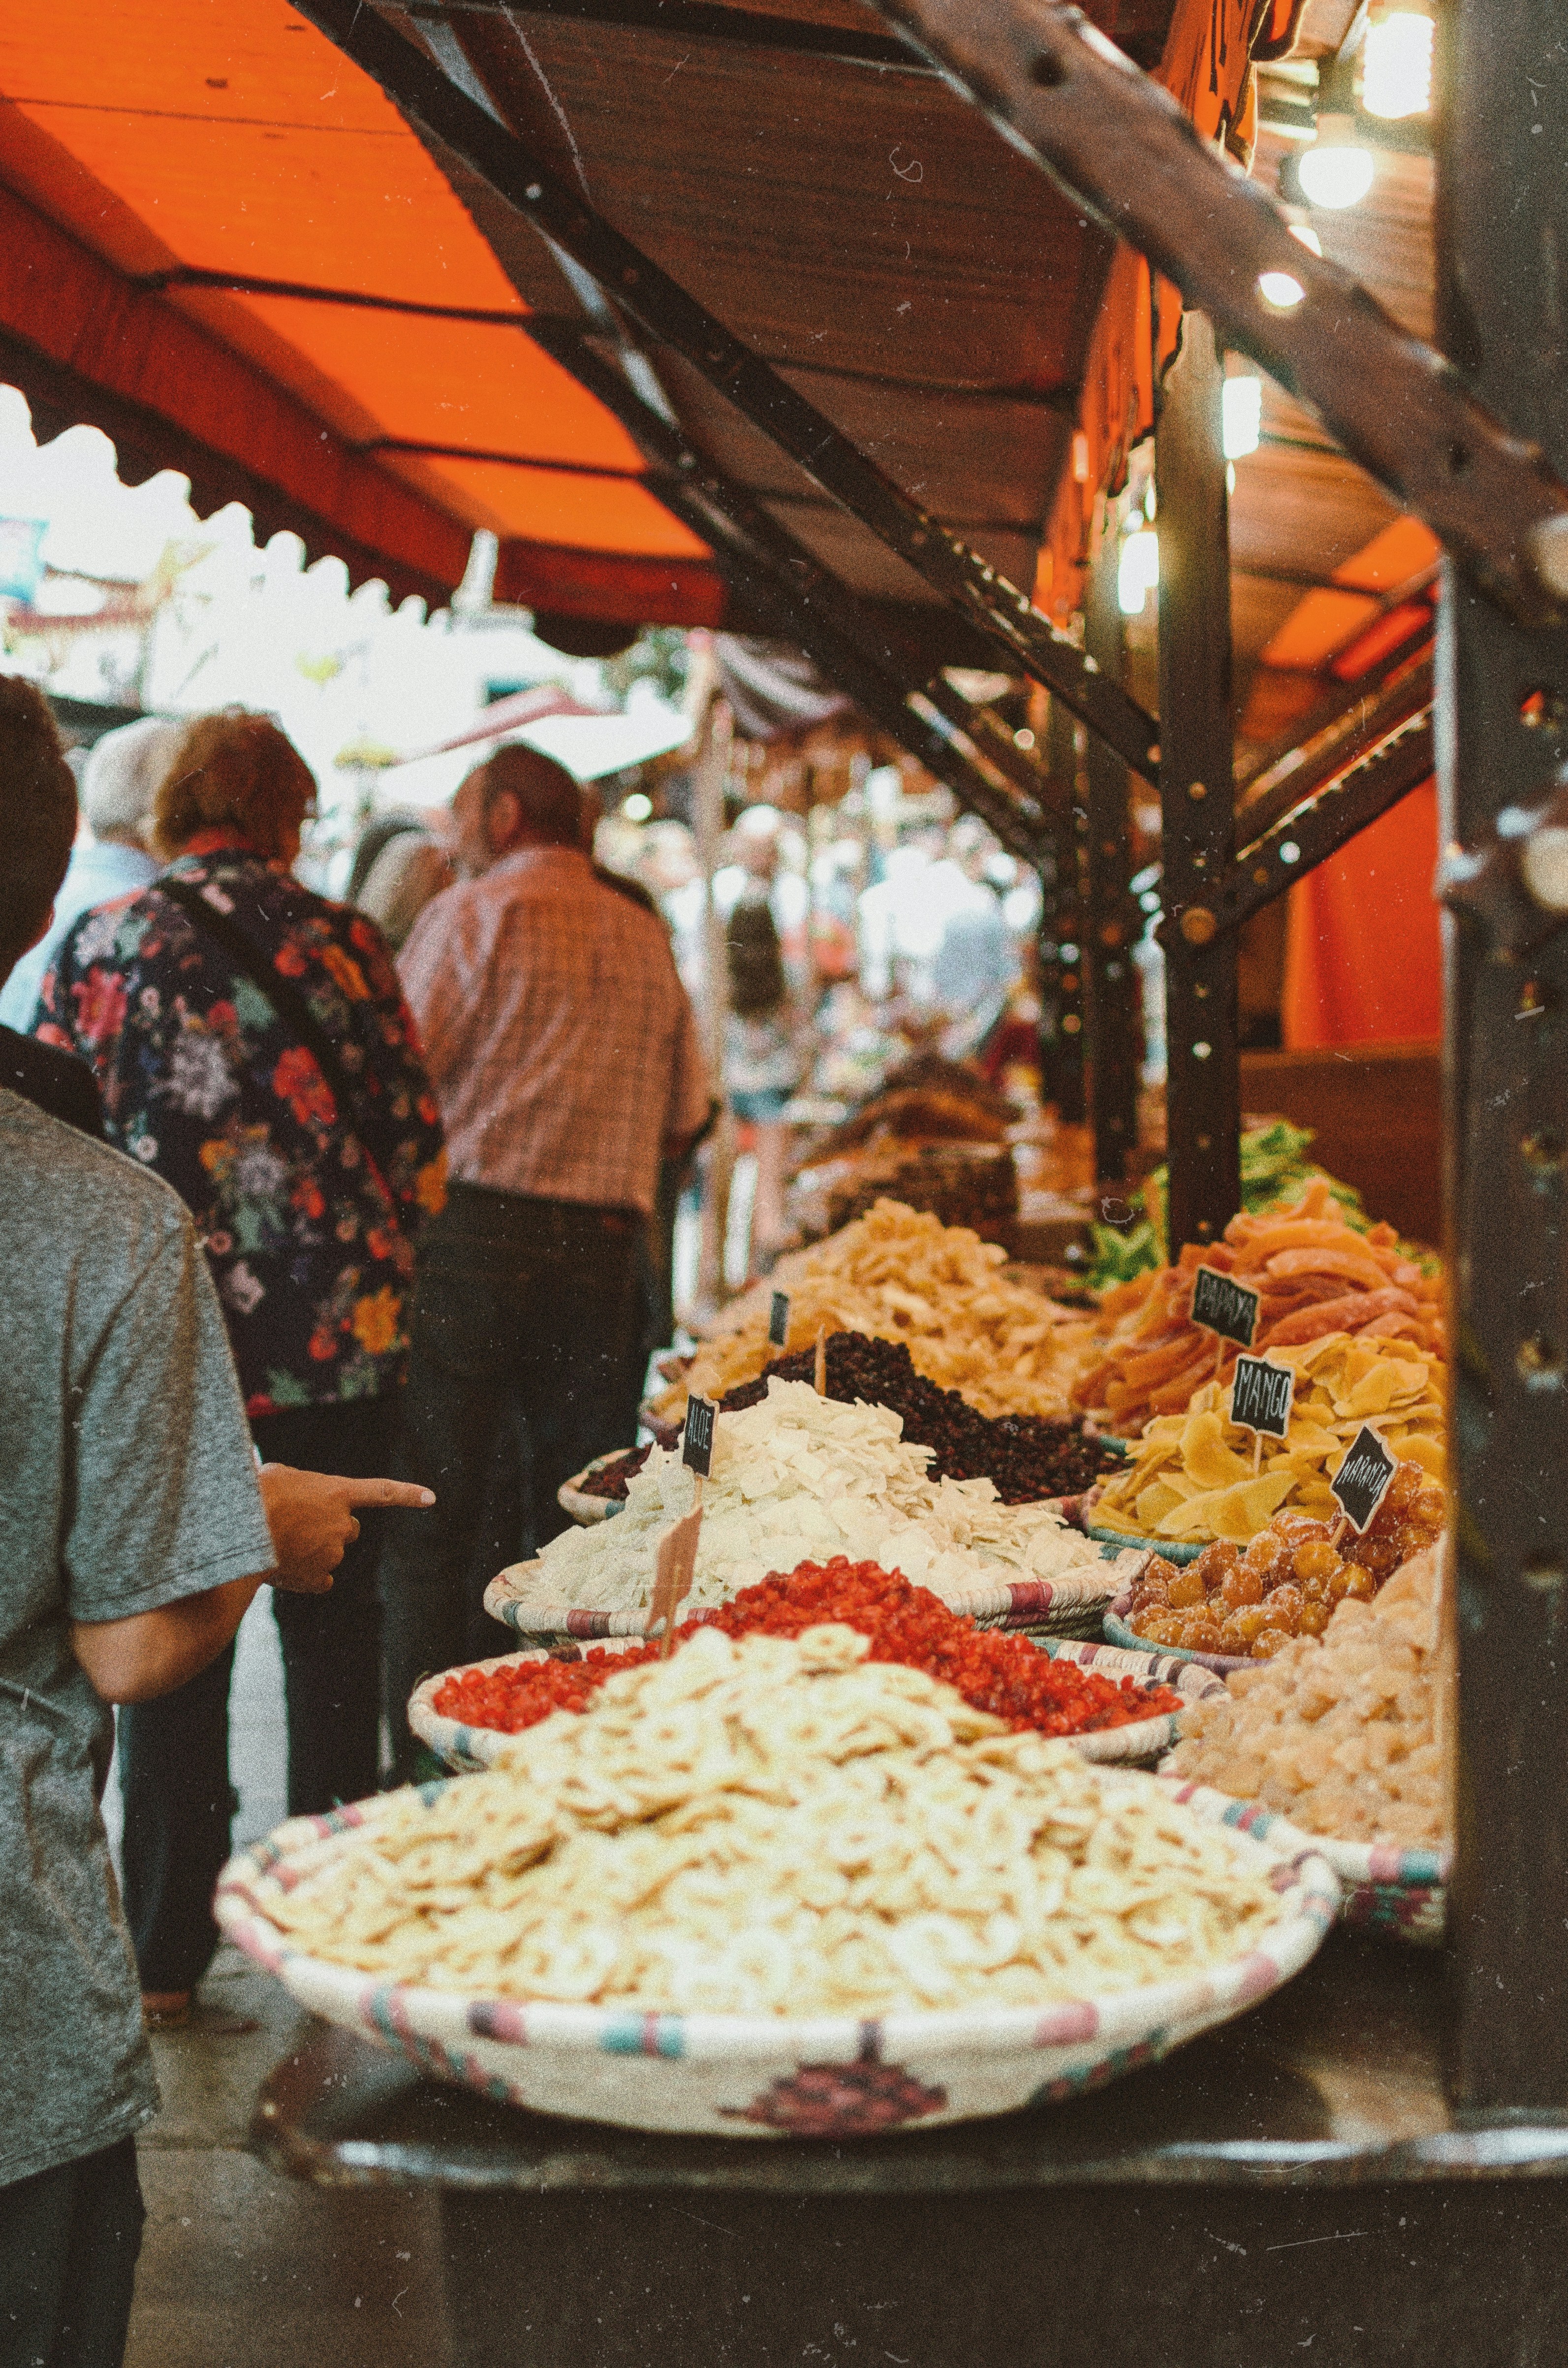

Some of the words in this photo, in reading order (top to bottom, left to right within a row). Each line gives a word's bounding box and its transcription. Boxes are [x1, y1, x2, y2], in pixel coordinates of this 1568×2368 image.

[1198, 1272, 1254, 1336] PAPAYA
[1237, 1364, 1291, 1420] MANGO
[688, 1403, 711, 1450] ALOE
[1337, 1455, 1388, 1504] NARANJA
